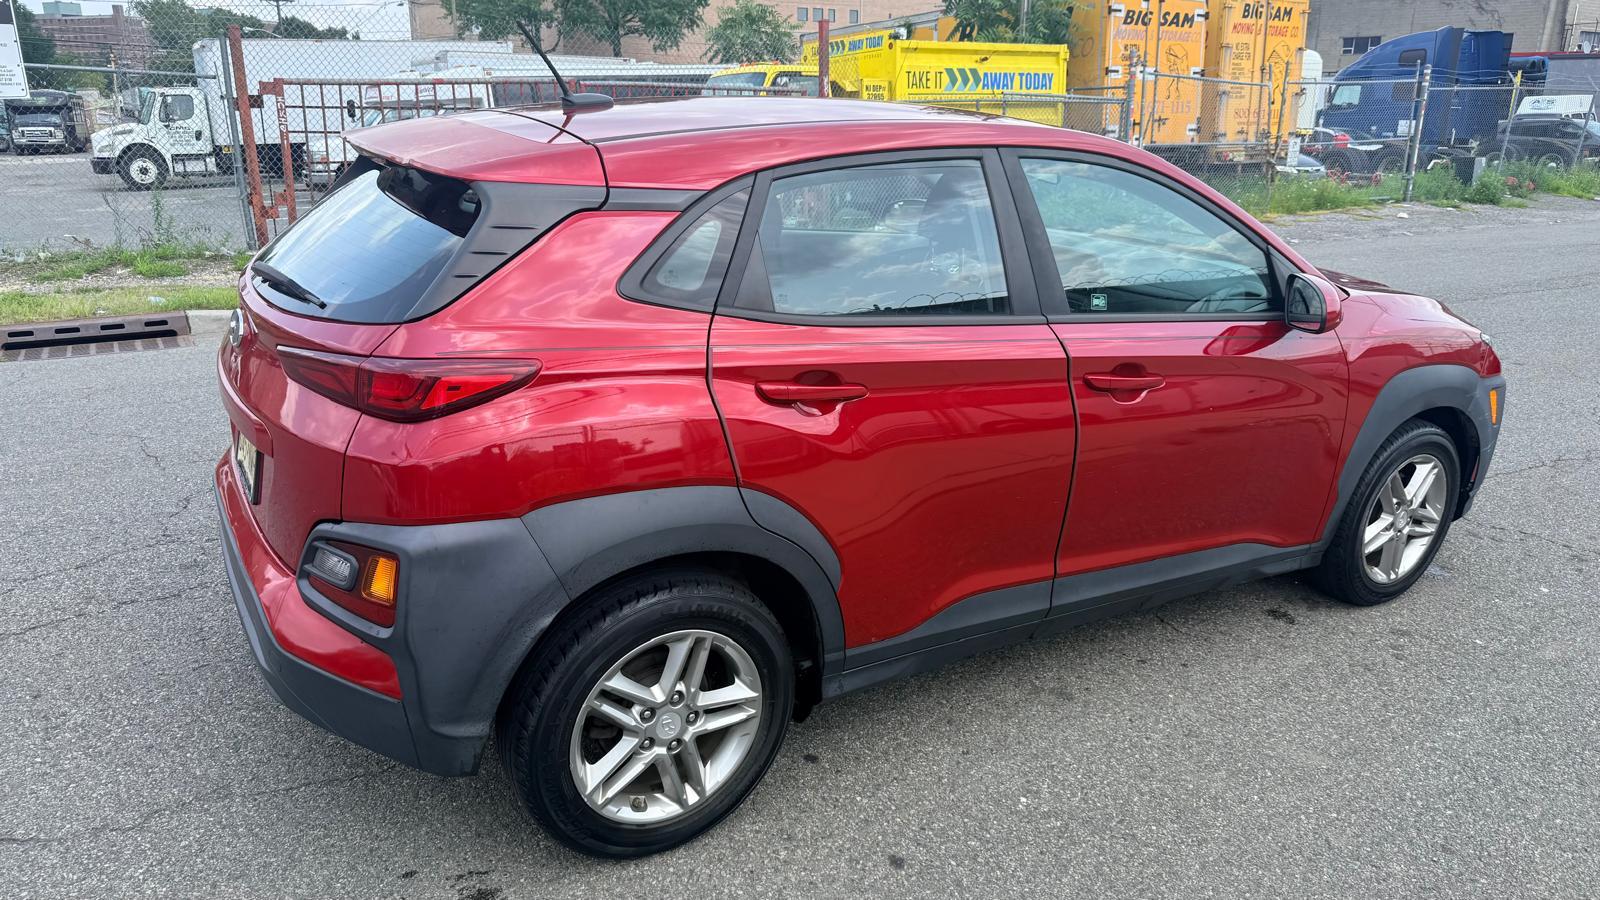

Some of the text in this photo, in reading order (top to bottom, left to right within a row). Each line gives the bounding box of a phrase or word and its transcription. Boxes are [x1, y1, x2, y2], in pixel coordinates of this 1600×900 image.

[1122, 9, 1195, 28] BIG SAM
[1242, 3, 1293, 22] BIG SAM
[1231, 22, 1255, 34] MOVING
[1268, 25, 1289, 37] TORAGE
[848, 35, 884, 52] AWAY TODAY
[906, 71, 1054, 90] TAKE IT AWAY TODAY
